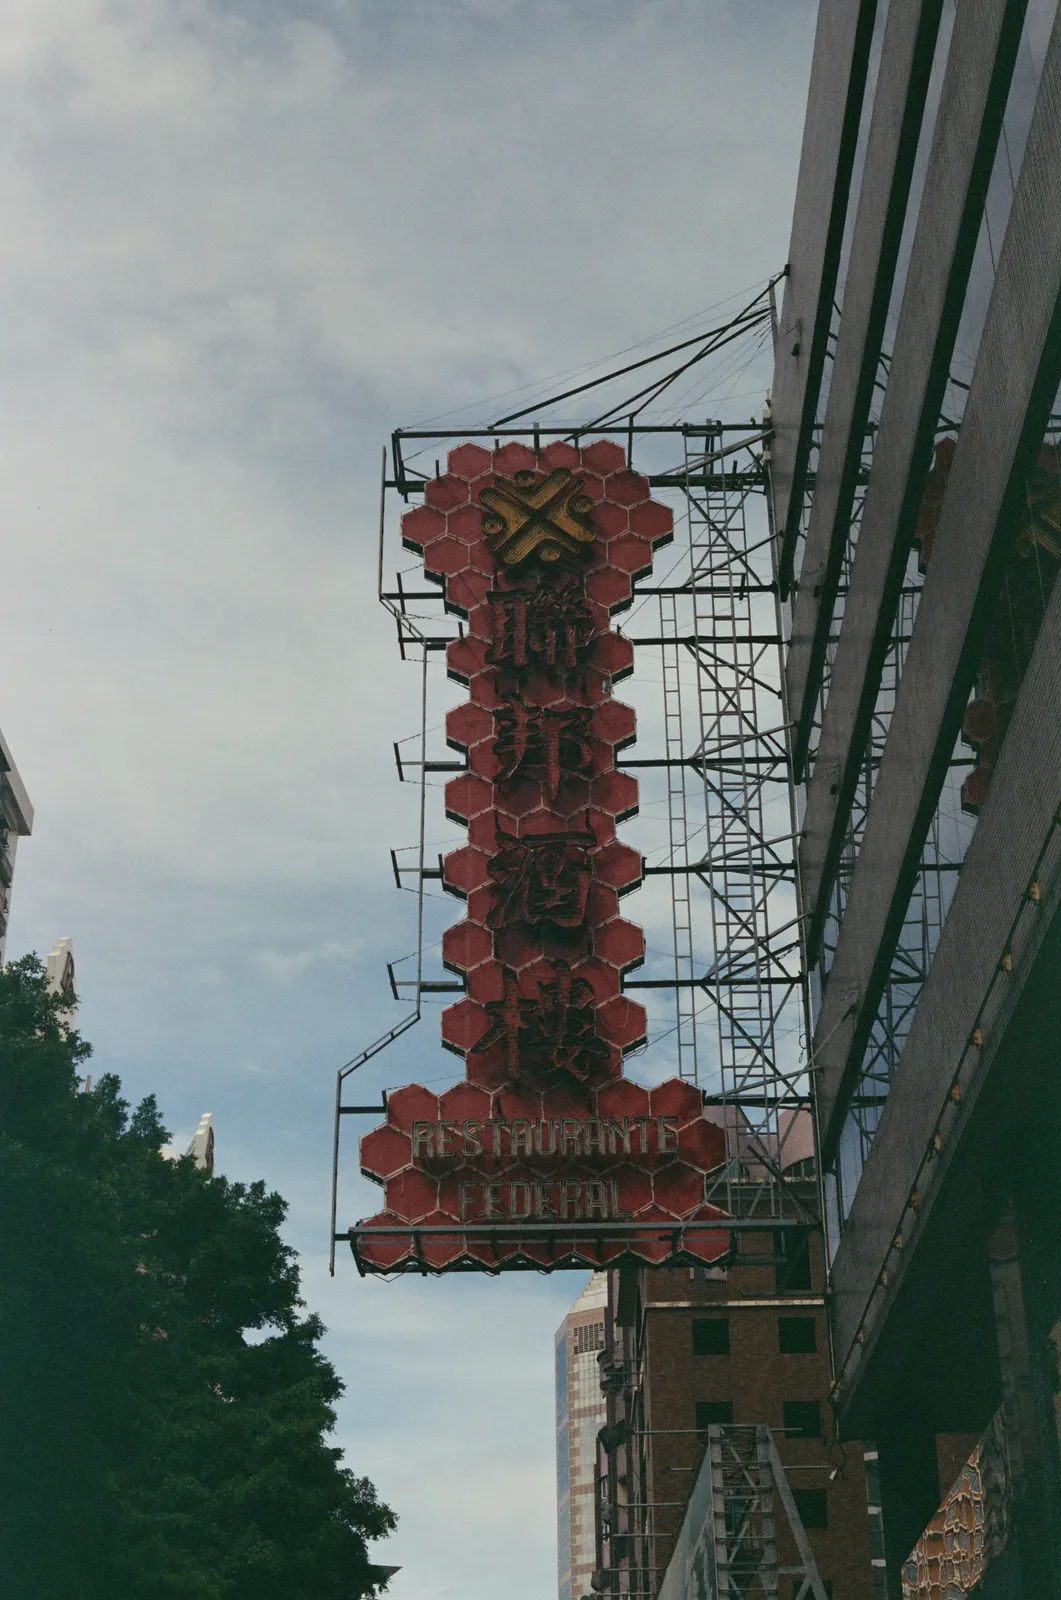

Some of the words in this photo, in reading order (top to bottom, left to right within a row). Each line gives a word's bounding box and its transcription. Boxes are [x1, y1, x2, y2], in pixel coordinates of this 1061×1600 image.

[475, 584, 609, 1082] 聯邦酒樓
[413, 1116, 678, 1158] RESTAURANTE
[459, 1178, 632, 1220] FEDERAL
